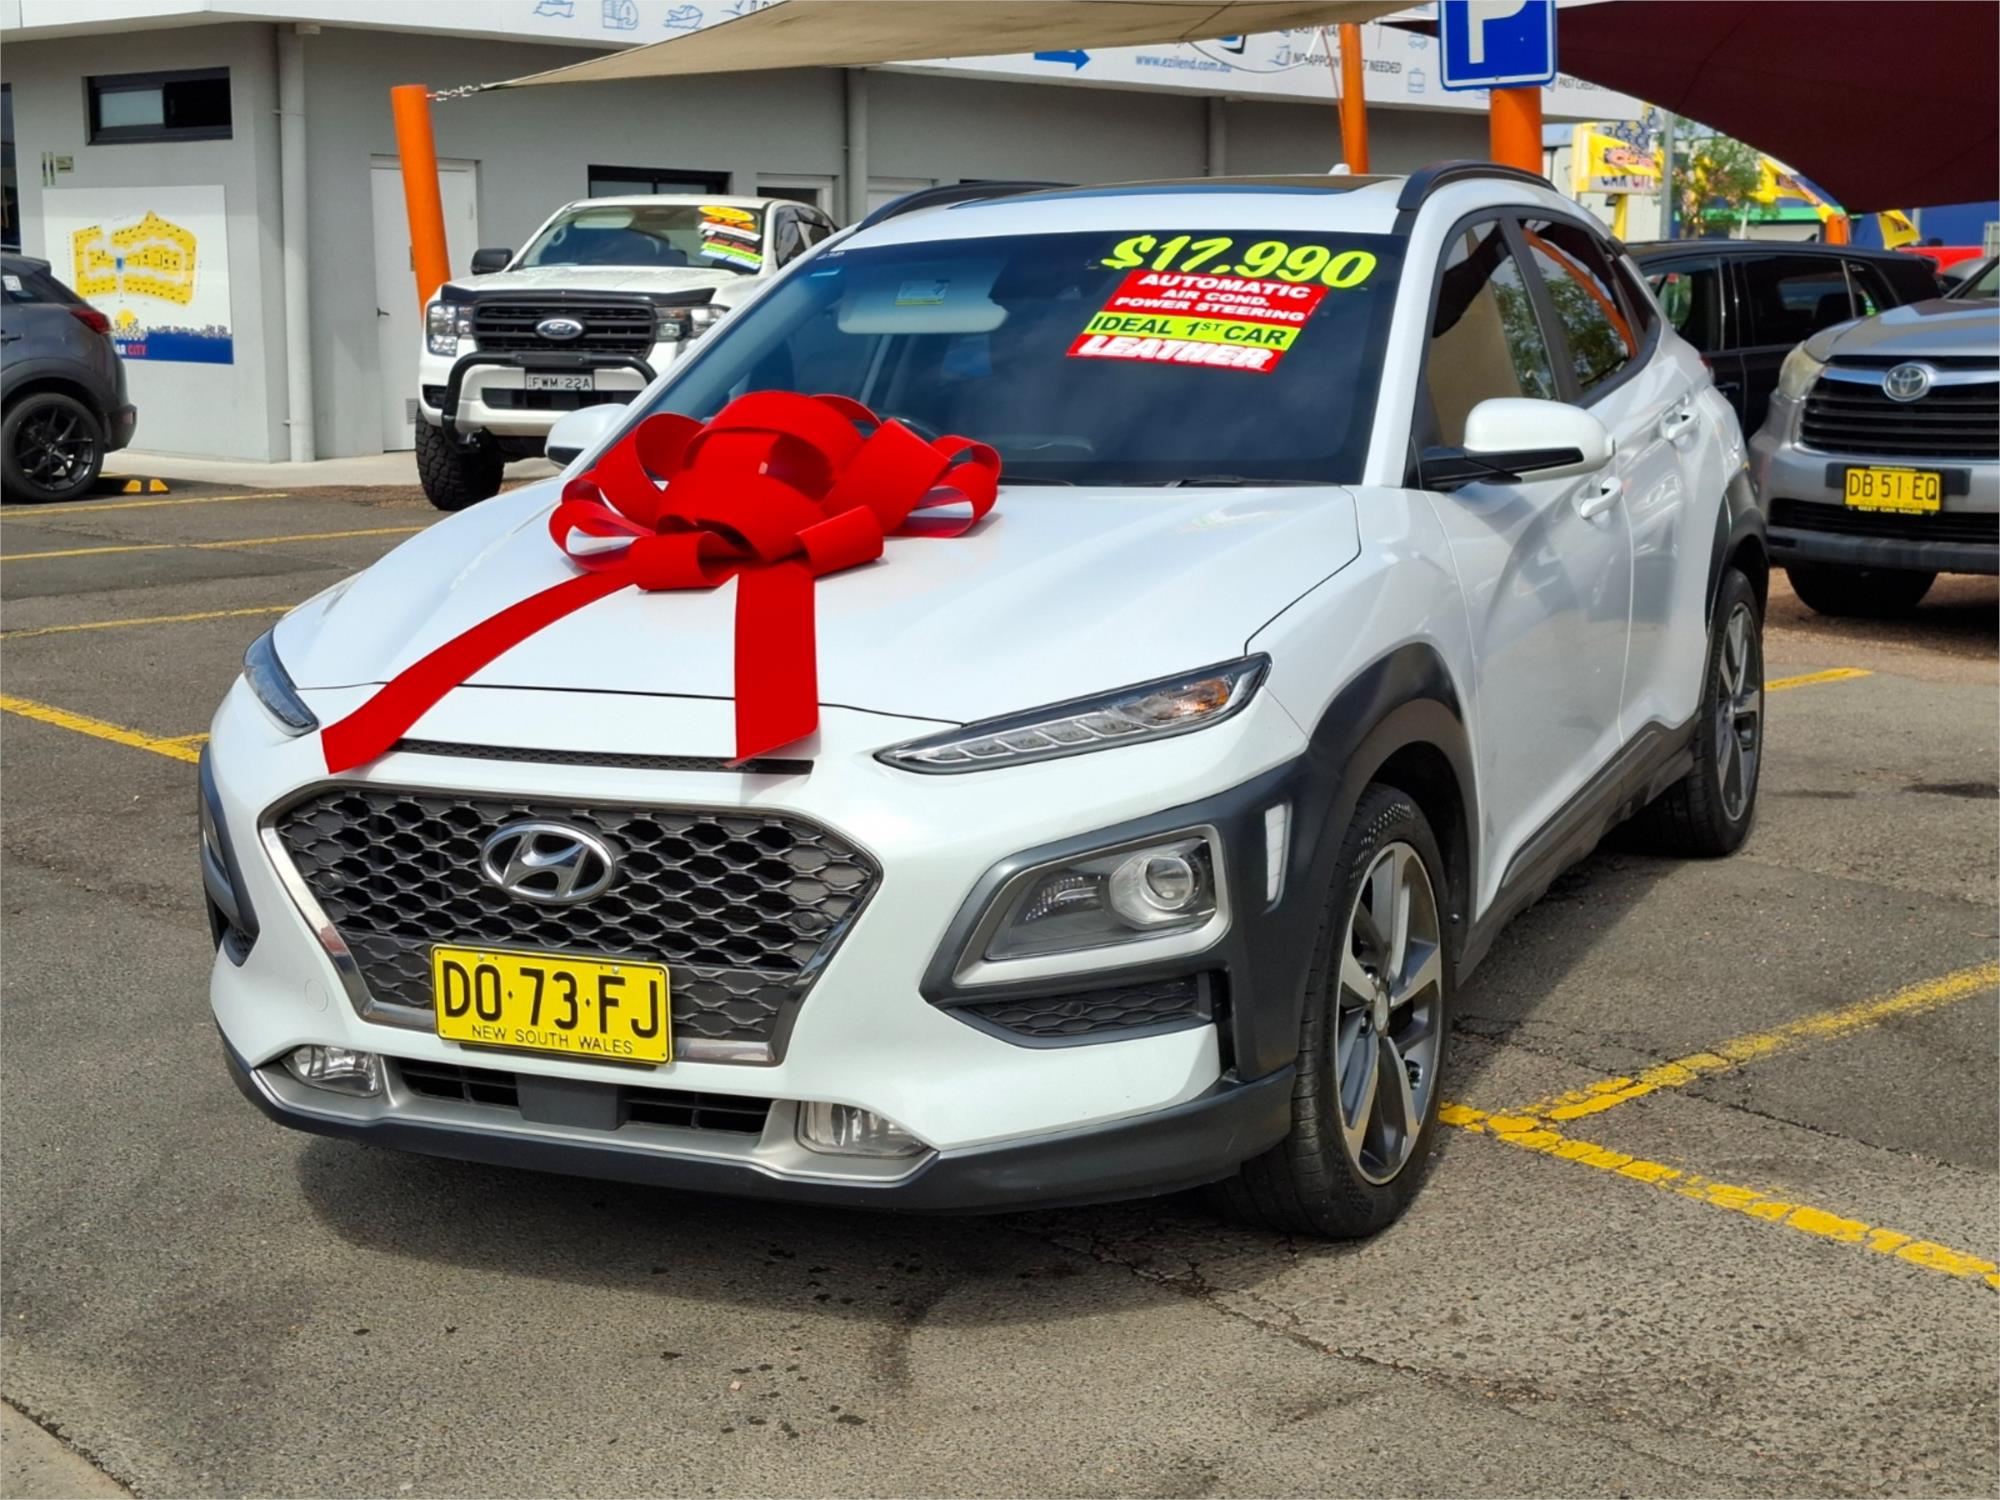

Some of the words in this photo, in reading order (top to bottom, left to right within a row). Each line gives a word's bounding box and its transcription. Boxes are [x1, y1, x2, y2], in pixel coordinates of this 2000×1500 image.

[1369, 60, 1402, 74] NEEDED
[1101, 234, 1377, 288] $17.990
[1138, 273, 1311, 299] AUTOMATIC
[1161, 289, 1200, 301] AIR
[1205, 292, 1270, 307] COND.
[1114, 296, 1190, 313] POWER
[1195, 302, 1305, 322] STEERING
[1090, 315, 1172, 336] IDEAL
[1186, 321, 1223, 336] 1ST
[1223, 324, 1288, 346] CAR
[128, 344, 147, 356] CITY
[1078, 335, 1274, 369] LEATHER
[471, 1025, 507, 1040] NEW
[515, 1028, 568, 1047] SOUTH
[579, 1037, 633, 1055] WALES
